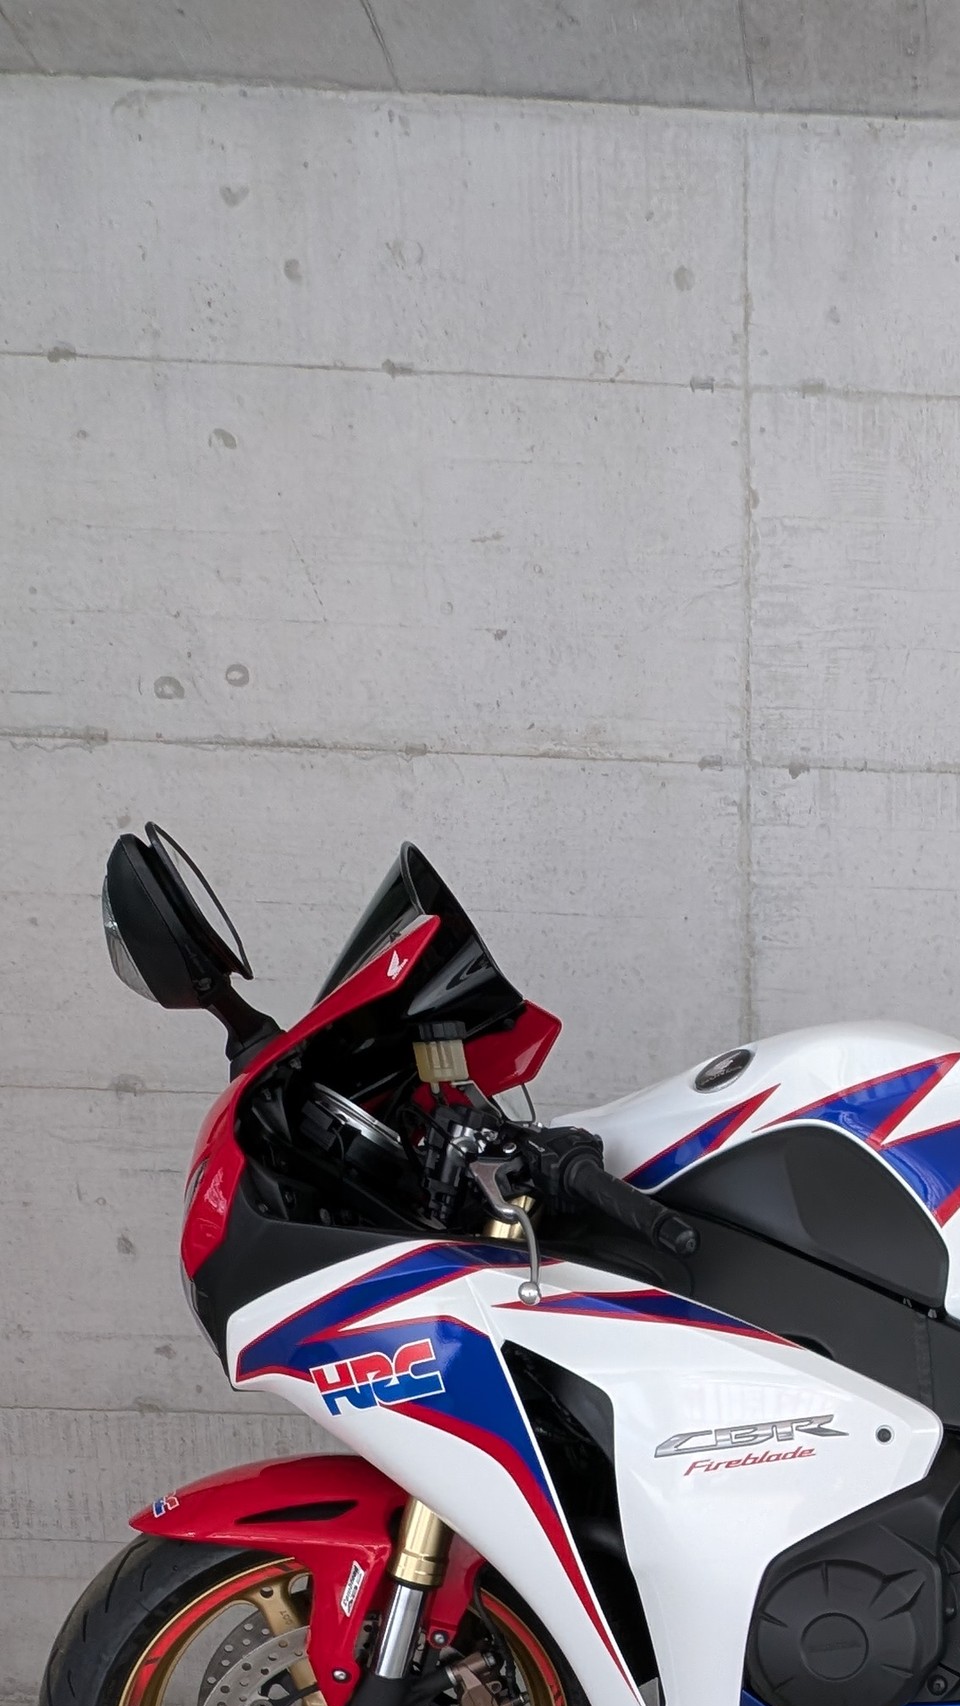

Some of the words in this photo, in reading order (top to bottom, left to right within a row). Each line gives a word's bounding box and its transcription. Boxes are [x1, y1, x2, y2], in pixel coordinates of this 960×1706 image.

[309, 1338, 446, 1416] HRC
[654, 1414, 849, 1458] CBR
[684, 1446, 816, 1476] Fireblade
